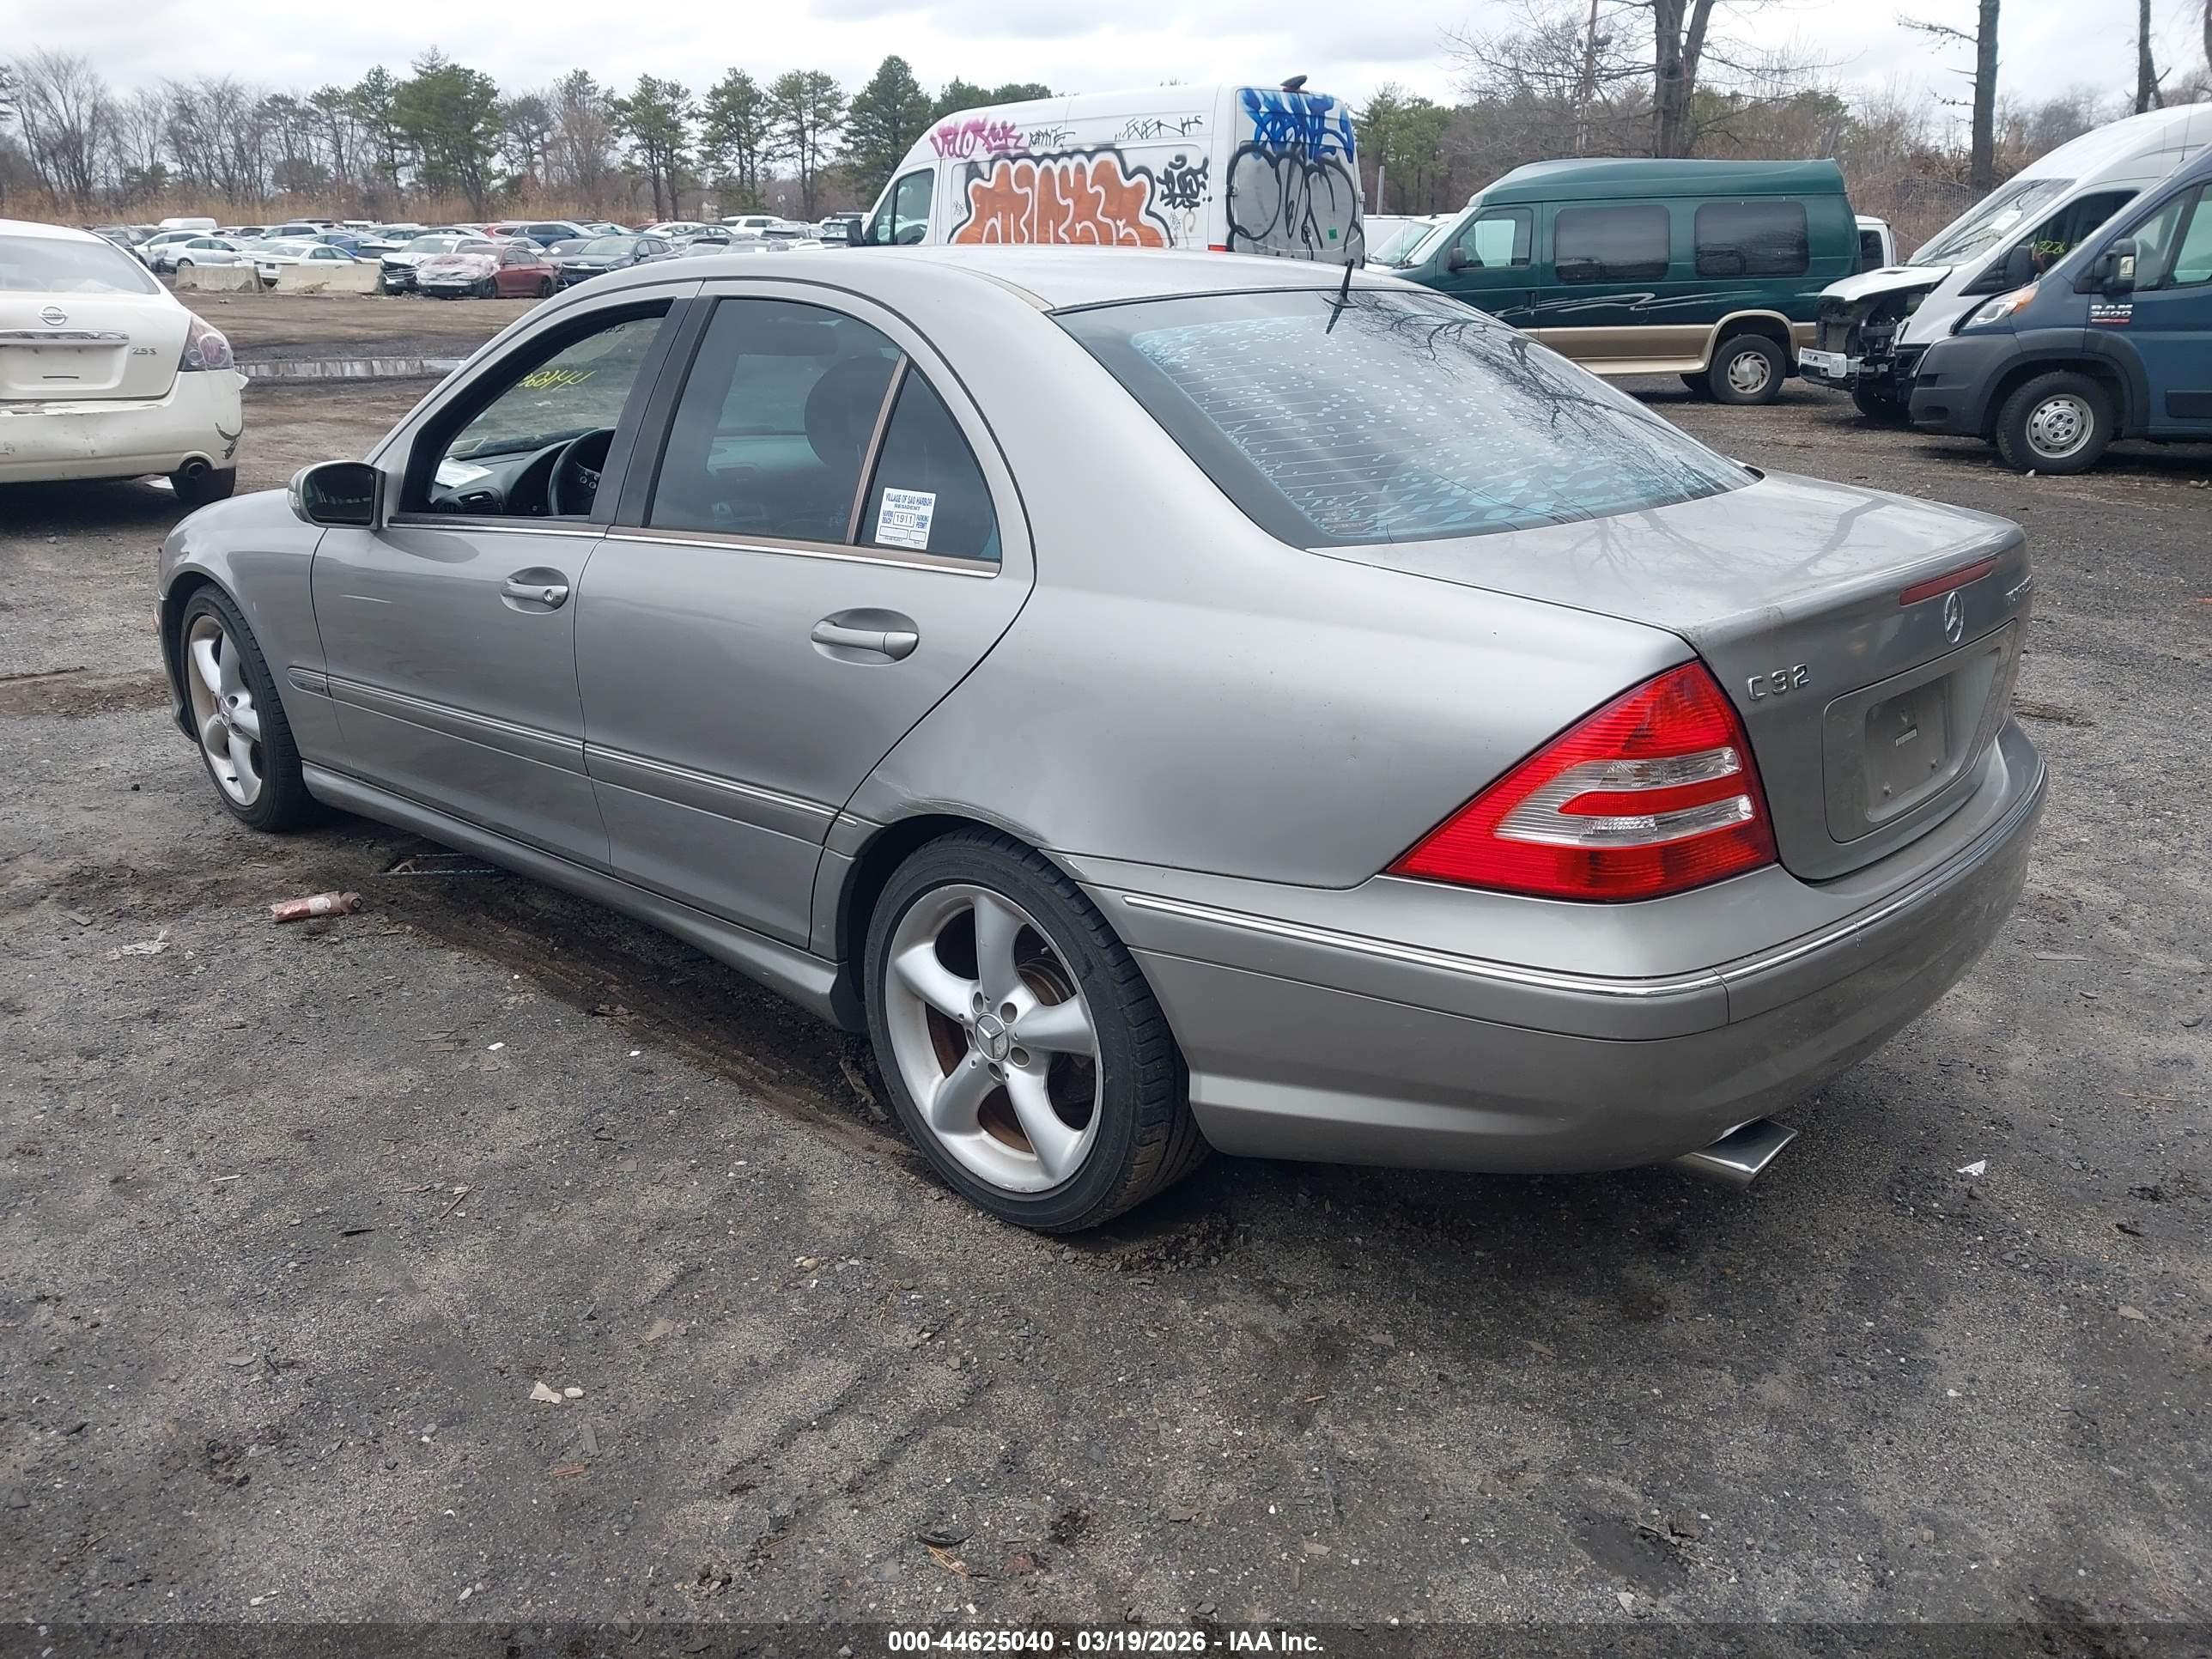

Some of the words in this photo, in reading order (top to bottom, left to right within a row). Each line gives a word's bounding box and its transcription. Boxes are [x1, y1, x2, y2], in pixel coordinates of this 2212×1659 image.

[885, 493, 901, 503] VILLAGE
[896, 514, 912, 525] 1911
[1747, 663, 1810, 701] C32
